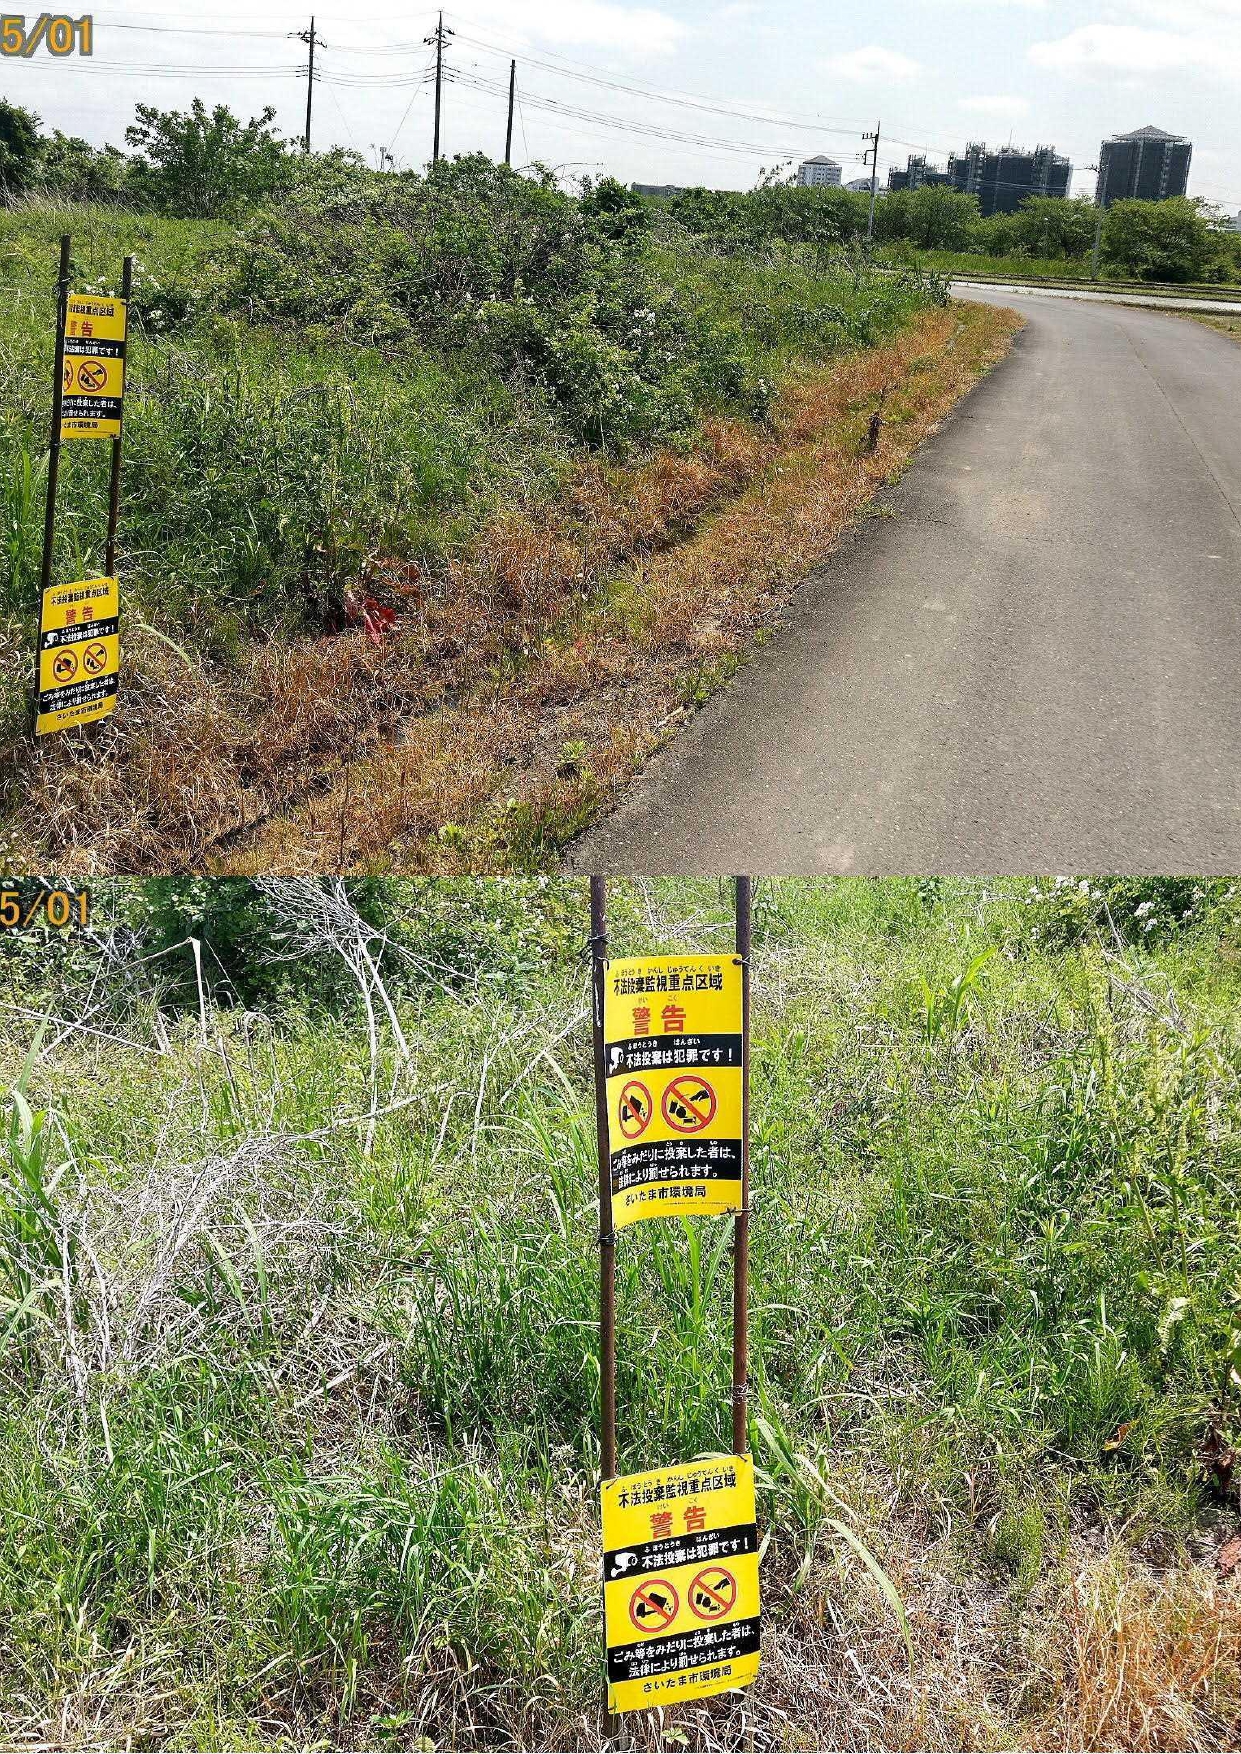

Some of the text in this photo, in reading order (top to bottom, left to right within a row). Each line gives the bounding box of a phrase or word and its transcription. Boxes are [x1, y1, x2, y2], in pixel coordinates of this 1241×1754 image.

[613, 973, 723, 996] 不法投棄監視重点区域
[632, 1004, 686, 1035] 警告
[625, 1185, 706, 1206] さいたま市環境局
[618, 1472, 736, 1509] 不法投棄監視重点区域
[650, 1505, 706, 1539] 警告
[628, 1645, 741, 1678] 法律により罰せられます。
[643, 1665, 732, 1693] さいたま市環境局
